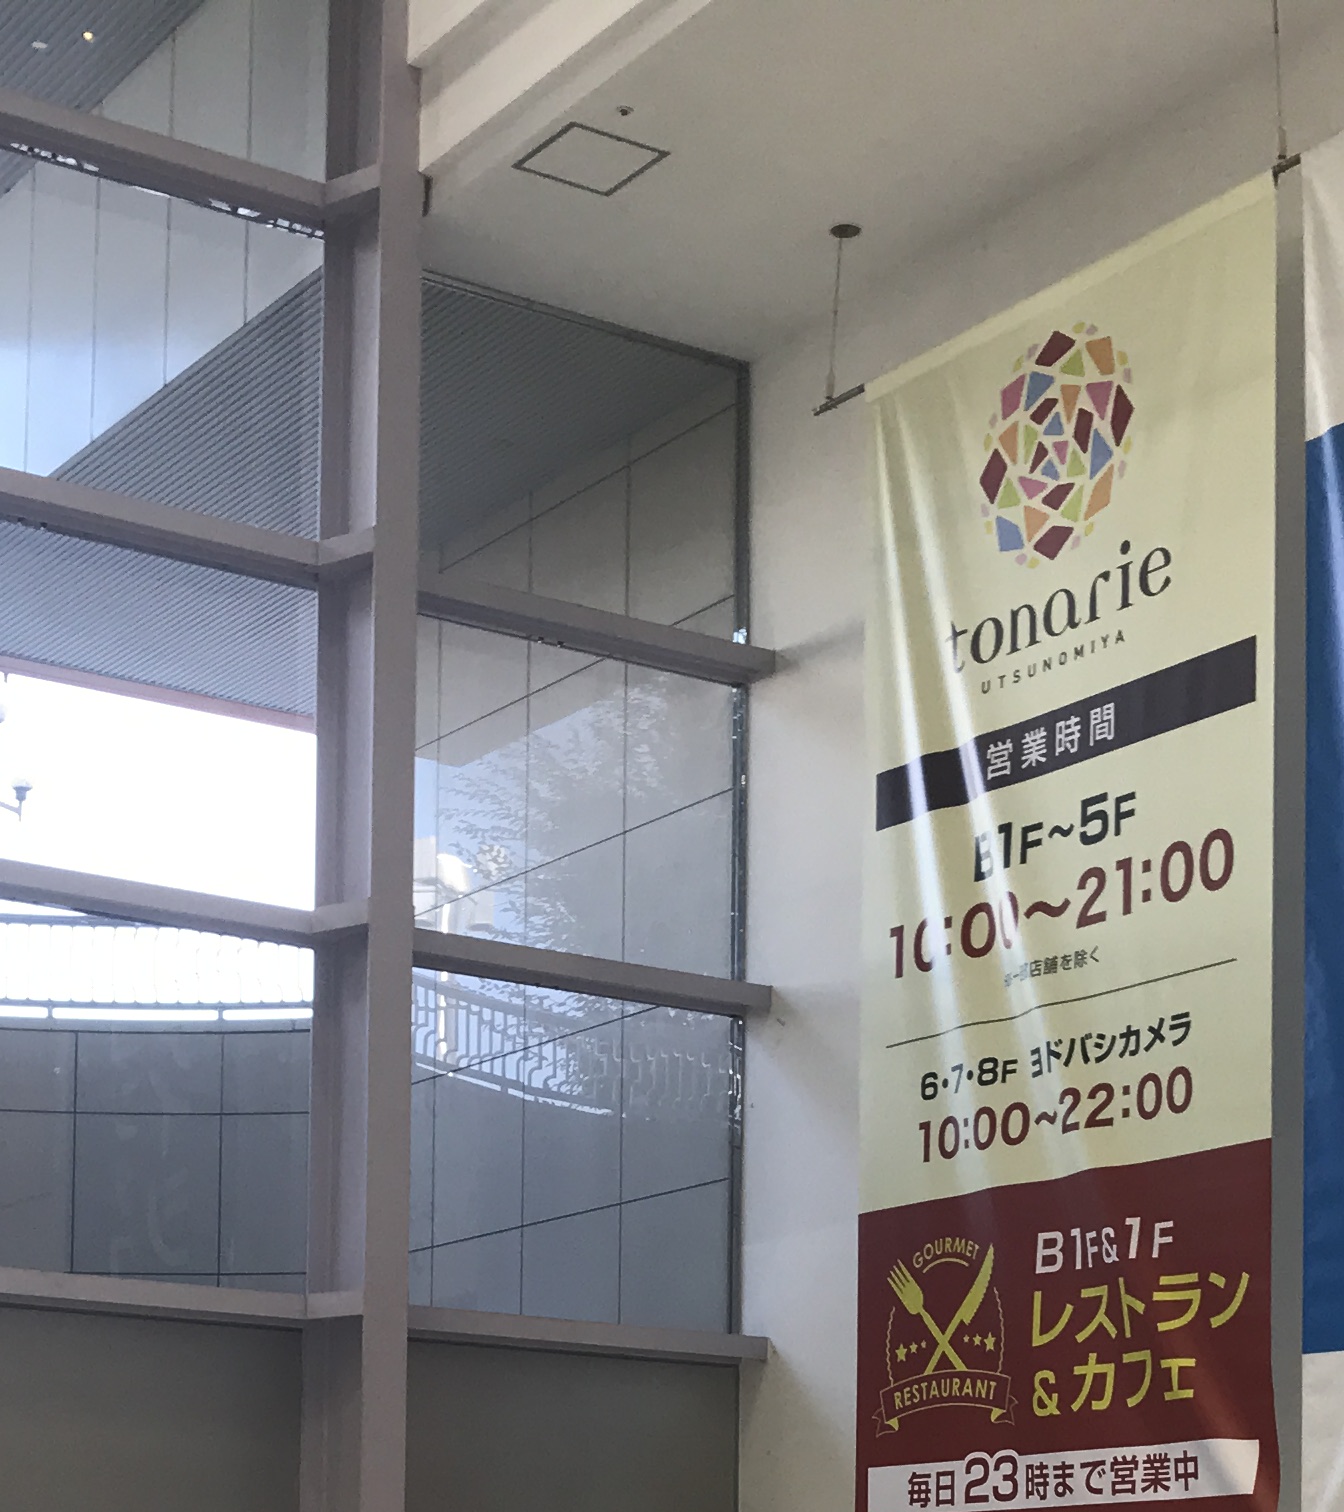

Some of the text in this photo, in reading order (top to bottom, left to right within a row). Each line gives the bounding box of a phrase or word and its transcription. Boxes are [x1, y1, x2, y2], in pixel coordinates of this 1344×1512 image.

[945, 540, 1173, 675] tonarie
[981, 630, 1127, 694] UTSUNOMIYA
[986, 702, 1116, 781] 営業時間
[1030, 1011, 1192, 1078] ヨドバシカメラ
[912, 1237, 980, 1269] GOURMET
[1032, 1272, 1250, 1347] レストラン
[893, 1378, 997, 1410] RESTAURANT
[907, 1449, 1200, 1509] 毎日23時まで営業中
